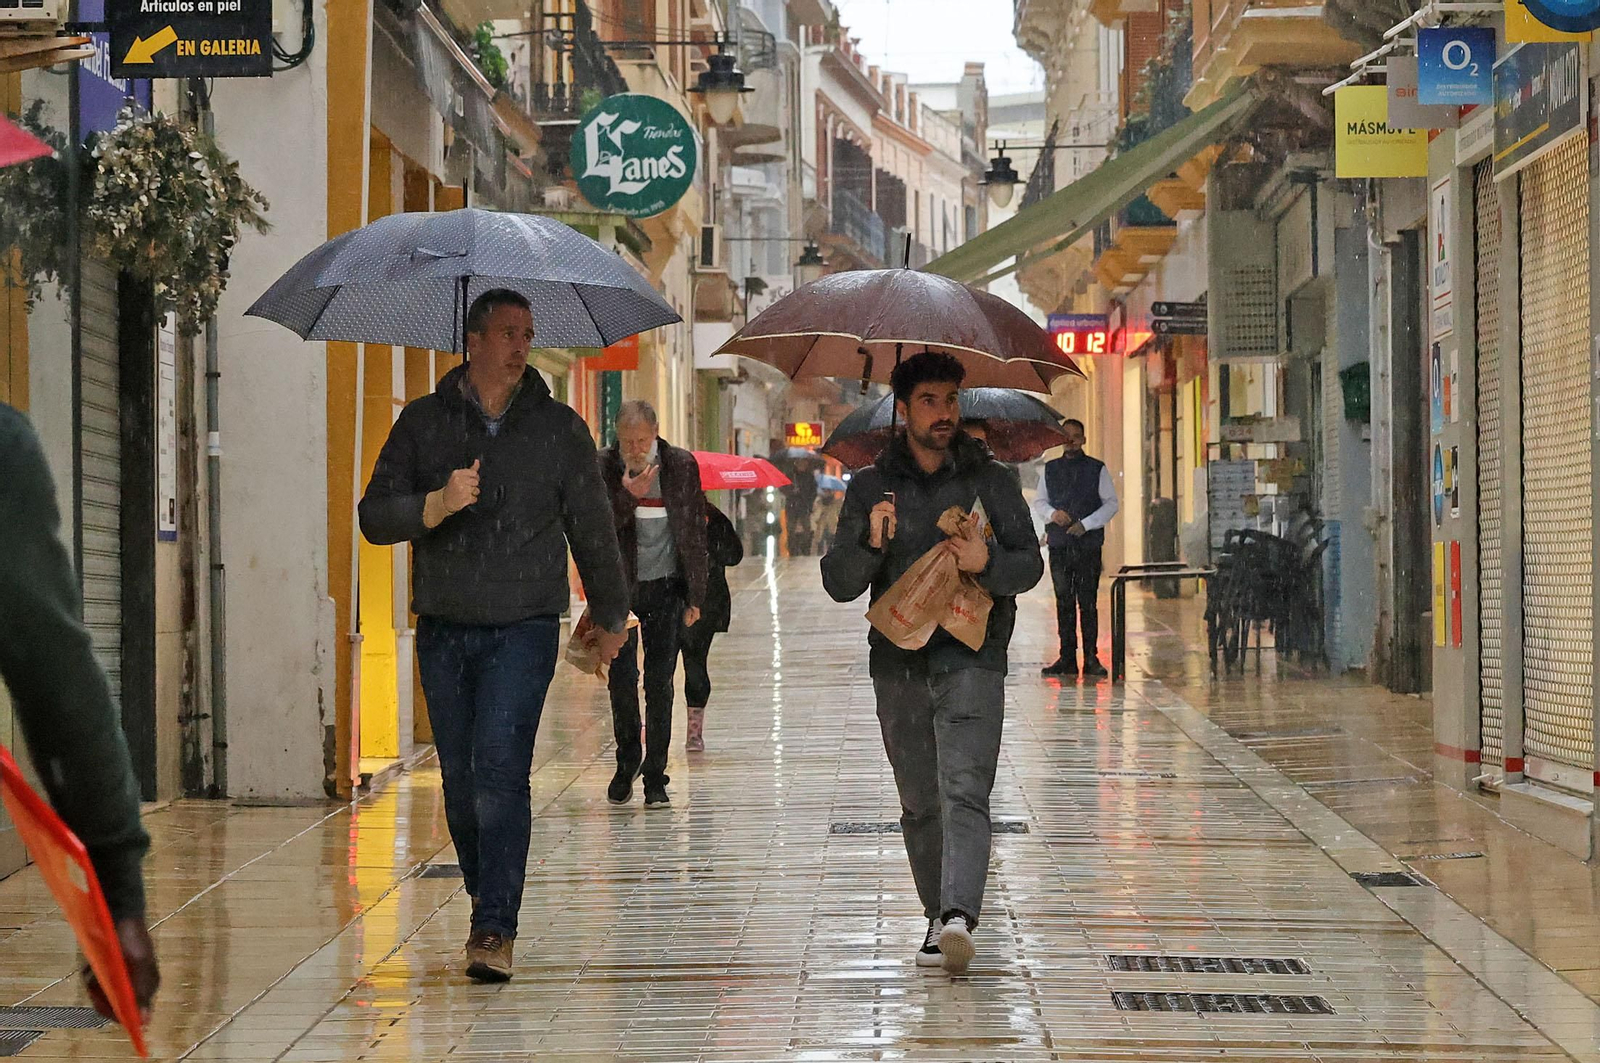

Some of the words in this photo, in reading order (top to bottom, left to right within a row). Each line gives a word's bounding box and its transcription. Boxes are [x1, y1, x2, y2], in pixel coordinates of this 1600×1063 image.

[197, 1, 213, 12] en
[217, 0, 241, 15] piel
[176, 40, 195, 56] EN
[200, 39, 261, 56] GALERIA
[1087, 332, 1106, 353] 12
